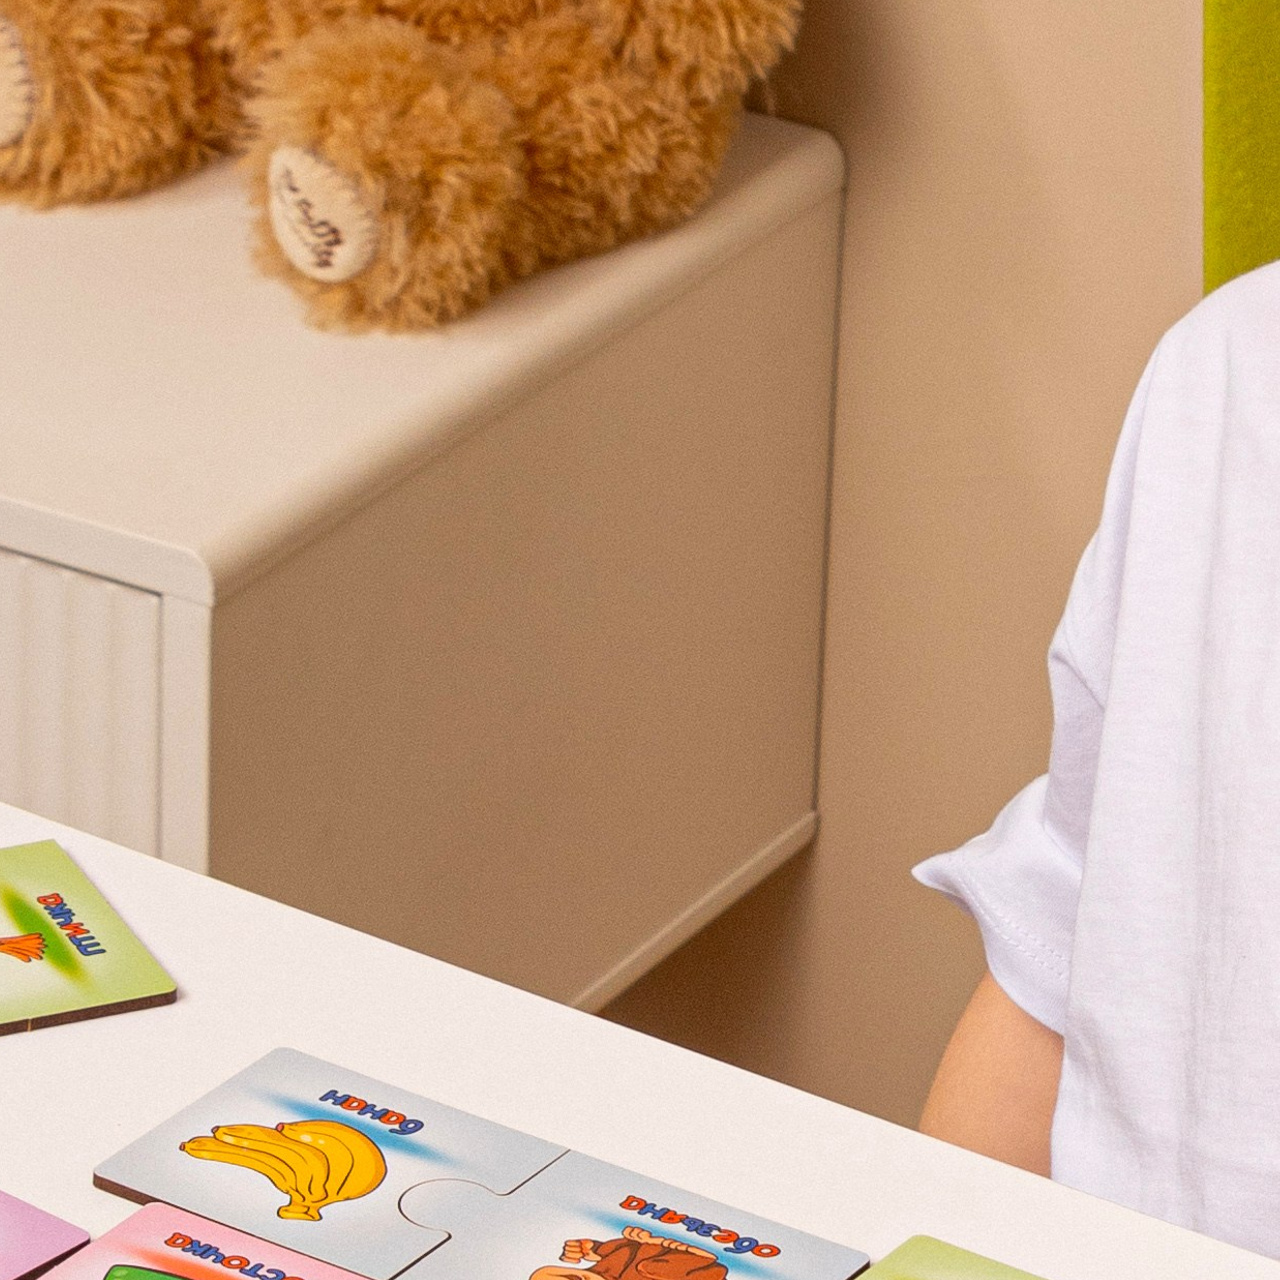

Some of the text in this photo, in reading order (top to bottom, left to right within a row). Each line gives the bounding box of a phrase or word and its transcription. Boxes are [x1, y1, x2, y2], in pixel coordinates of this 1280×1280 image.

[37, 892, 106, 957] птичка
[318, 1089, 424, 1136] банан
[619, 1194, 781, 1257] обезьяна
